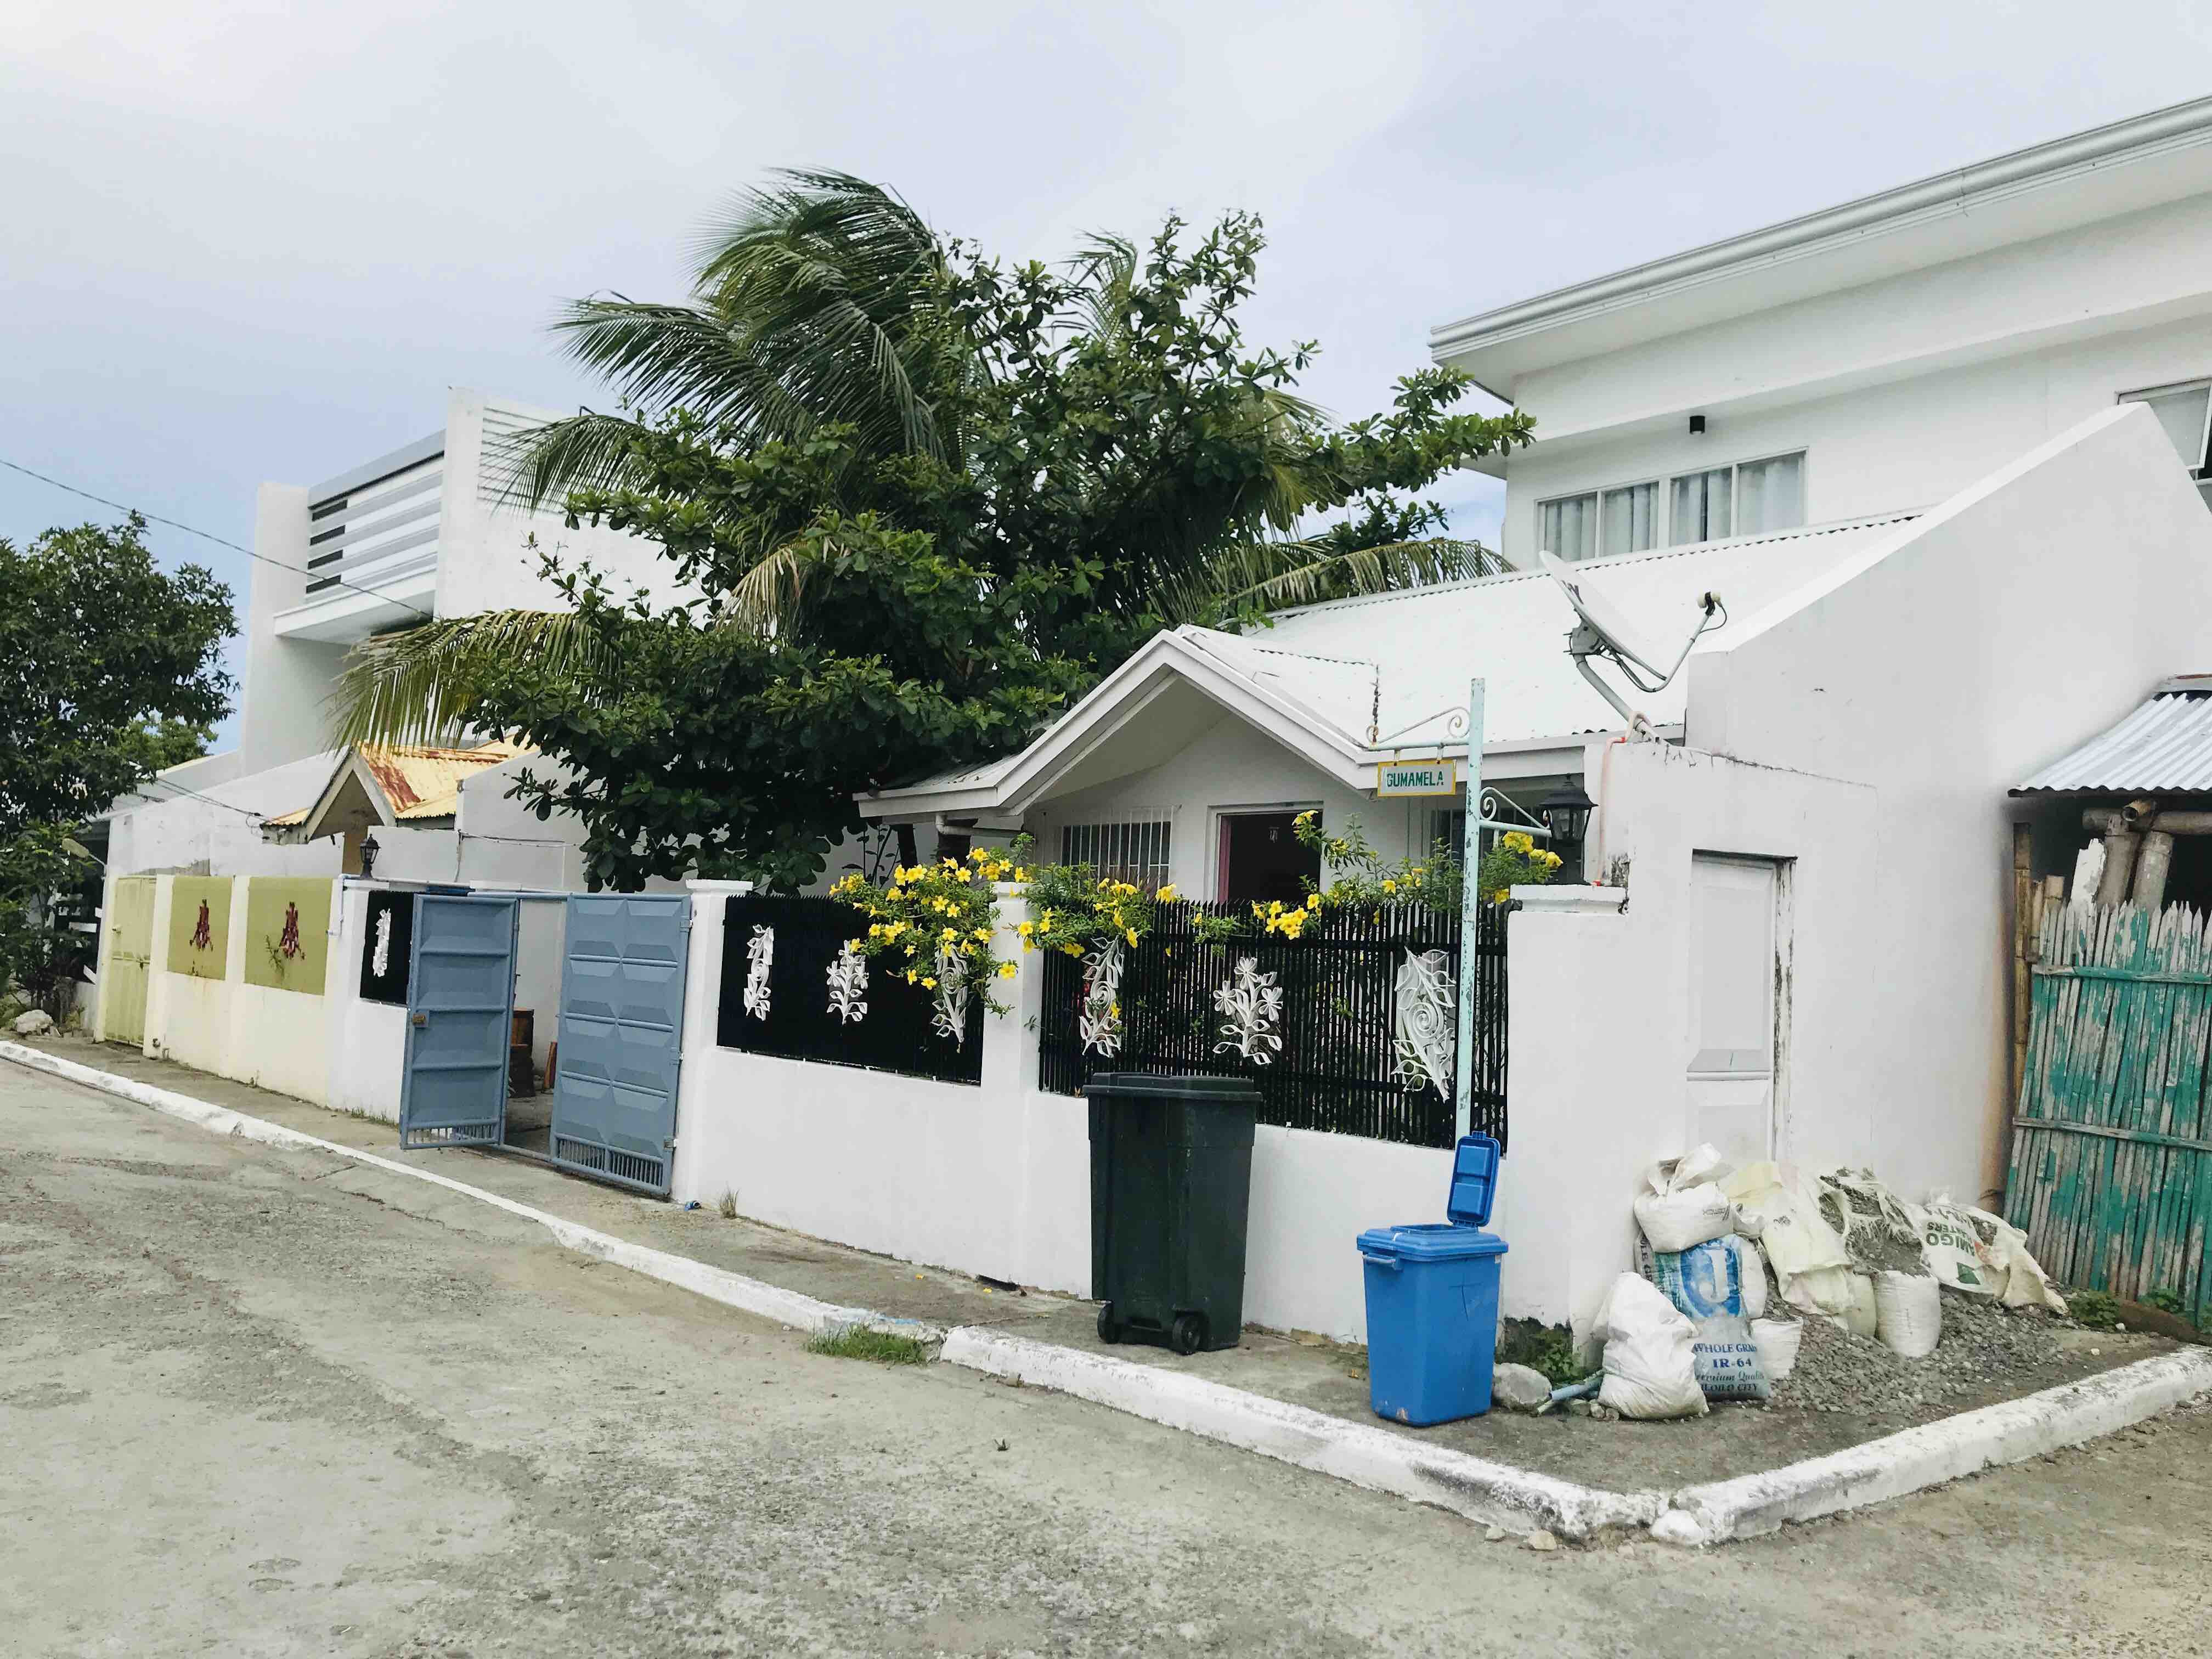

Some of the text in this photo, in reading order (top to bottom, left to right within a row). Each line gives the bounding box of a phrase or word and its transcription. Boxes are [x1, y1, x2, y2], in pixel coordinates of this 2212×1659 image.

[1386, 771, 1444, 787] GUMAMELA
[1926, 1232, 1975, 1256] AMIGO
[1694, 1343, 1734, 1353] WHOLE
[1712, 1357, 1752, 1368] IR-64
[1737, 1383, 1758, 1392] CITY
